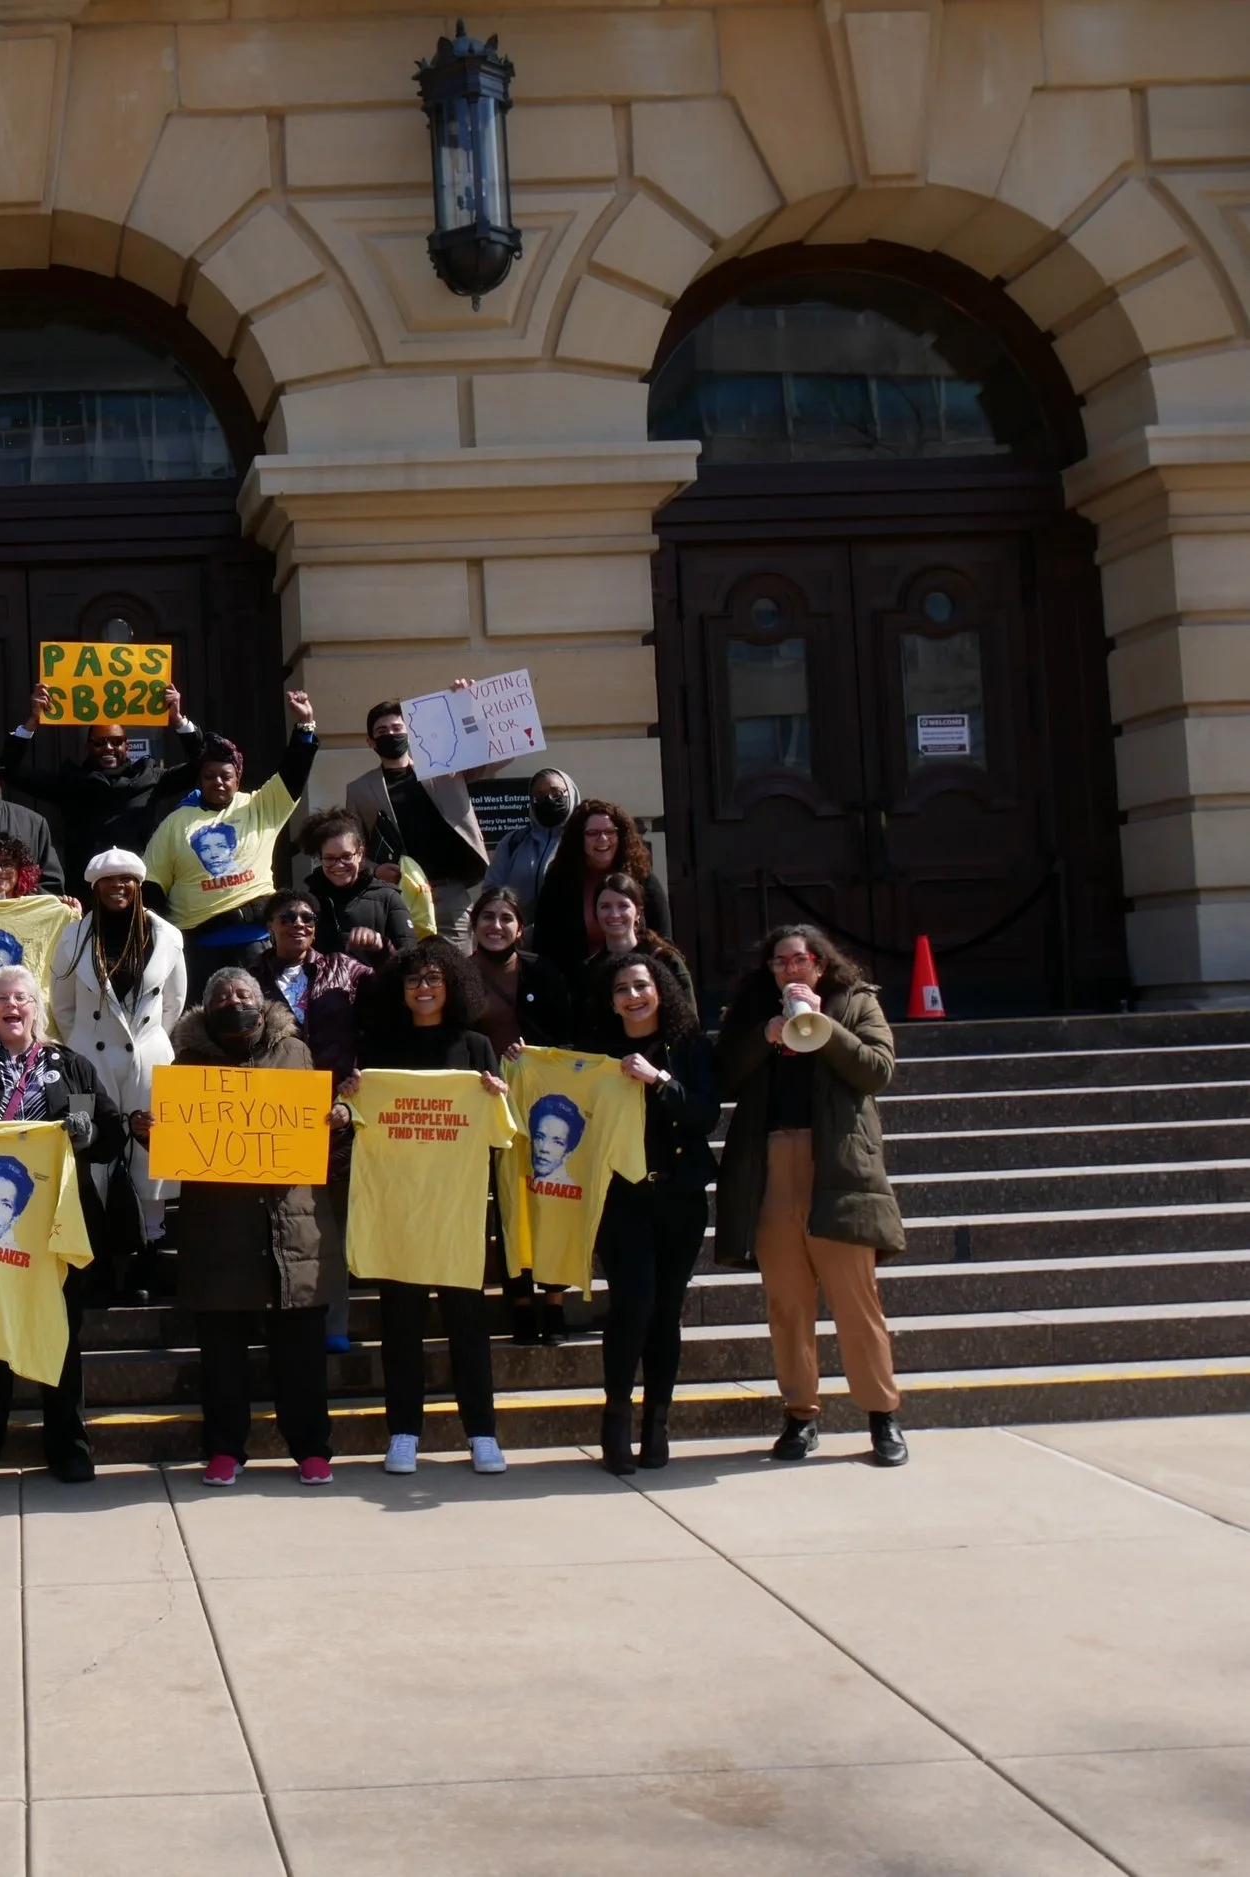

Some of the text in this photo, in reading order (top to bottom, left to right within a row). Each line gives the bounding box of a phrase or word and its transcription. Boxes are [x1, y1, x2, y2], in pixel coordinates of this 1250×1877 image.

[42, 644, 168, 677] PASS
[469, 674, 528, 700] VOTING
[482, 692, 533, 719] RIGHTS
[489, 718, 519, 737] FOR
[484, 795, 503, 803] West
[504, 794, 530, 802] Entran
[499, 803, 522, 811] Monday
[201, 869, 255, 891] ELLA BAKER
[204, 1069, 252, 1093] LET
[160, 1099, 317, 1129] EVERYONE
[394, 1098, 453, 1111] GIVE LIGHT
[378, 1112, 469, 1126] AND PEOPLE WILL
[388, 1127, 459, 1141] FIND THE WAY
[189, 1129, 293, 1168] VOTE
[545, 1182, 582, 1200] BAKER
